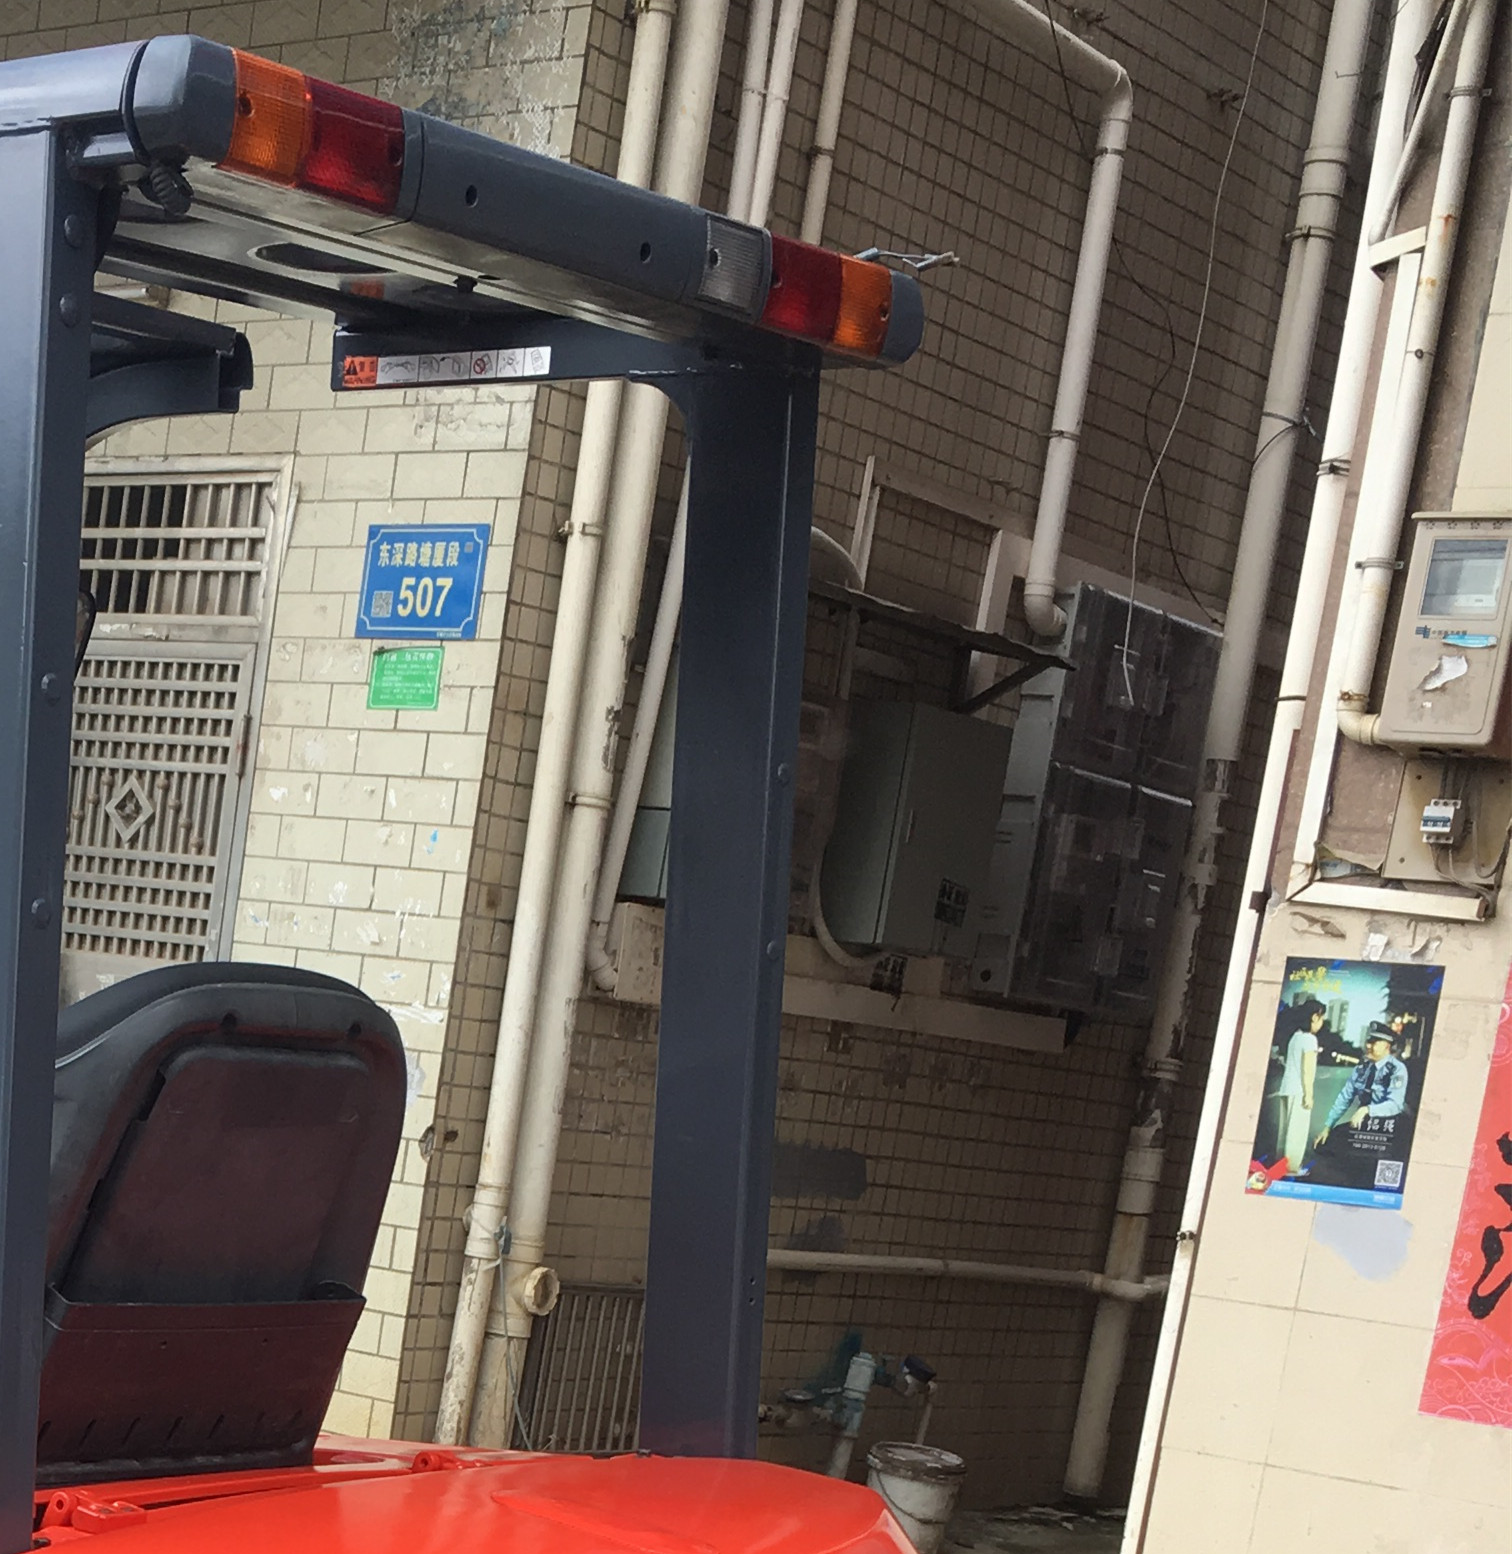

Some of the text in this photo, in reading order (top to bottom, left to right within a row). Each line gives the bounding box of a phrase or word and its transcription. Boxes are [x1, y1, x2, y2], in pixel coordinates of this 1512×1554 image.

[377, 541, 460, 567] 东深路塘厦段
[397, 577, 453, 617] 507
